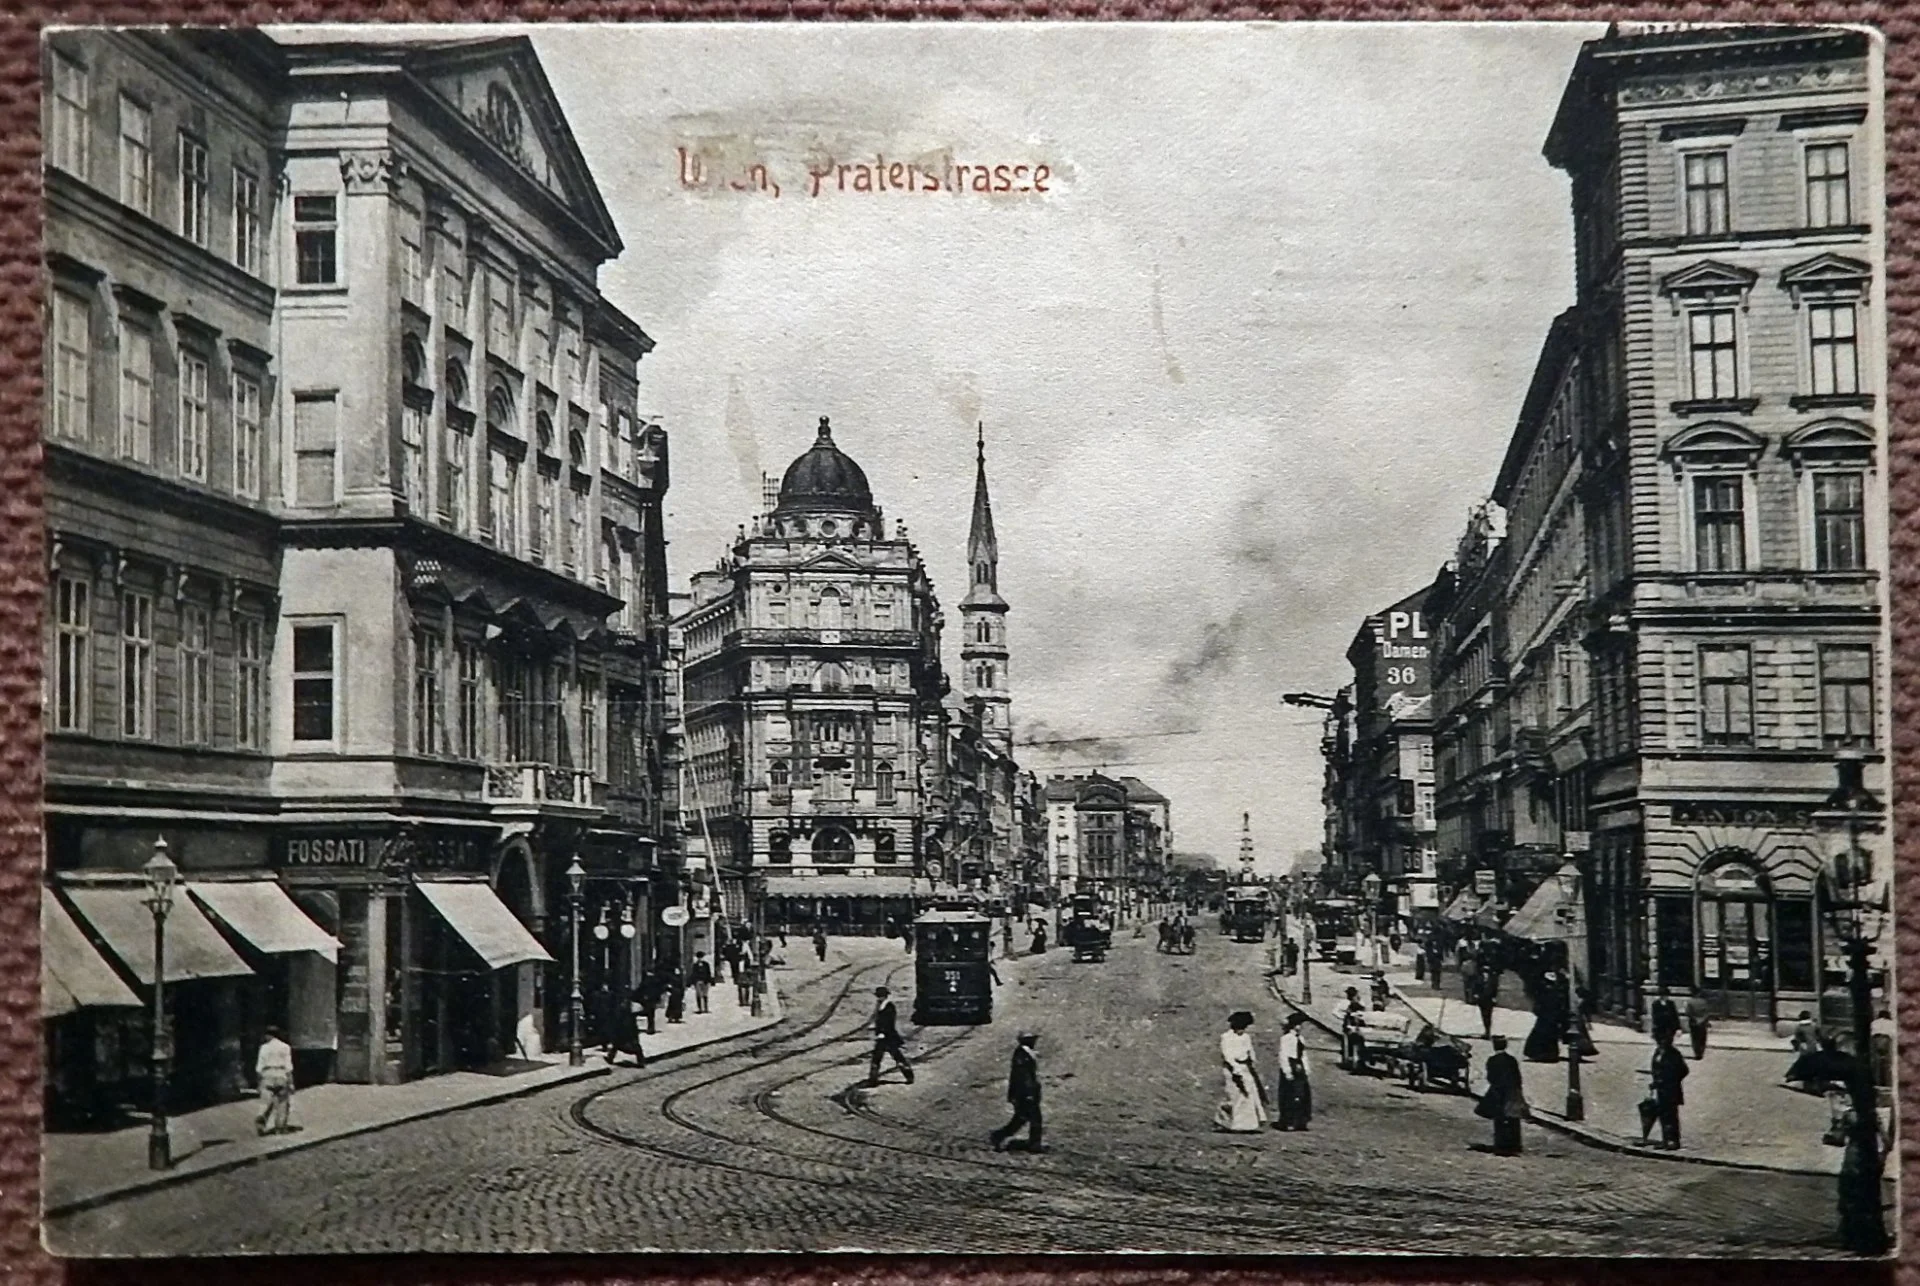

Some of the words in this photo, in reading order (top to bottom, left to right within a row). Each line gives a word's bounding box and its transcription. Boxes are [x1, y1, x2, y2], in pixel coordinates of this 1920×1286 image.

[1389, 611, 1428, 639] PL
[1386, 666, 1416, 685] 36
[288, 839, 365, 864] FOSSATI
